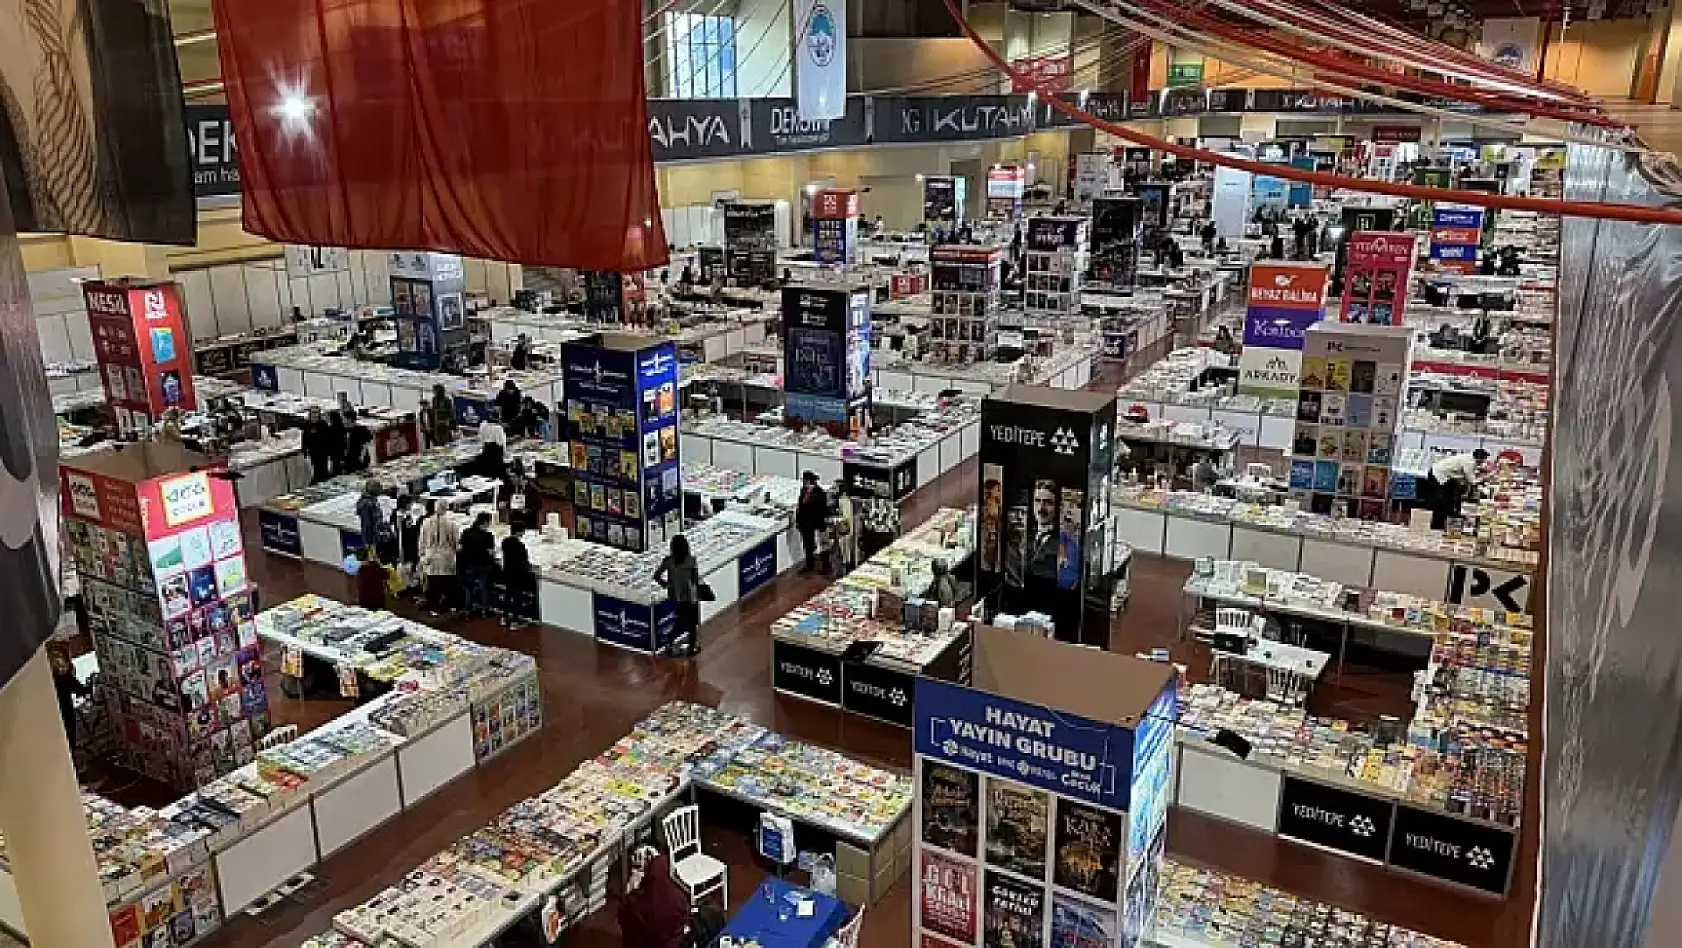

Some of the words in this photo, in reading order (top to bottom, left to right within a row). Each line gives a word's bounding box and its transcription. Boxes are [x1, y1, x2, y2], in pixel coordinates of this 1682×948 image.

[985, 705, 1056, 738] HAYAT
[950, 719, 1012, 750] YAYIN
[1016, 735, 1097, 771] GRUBU
